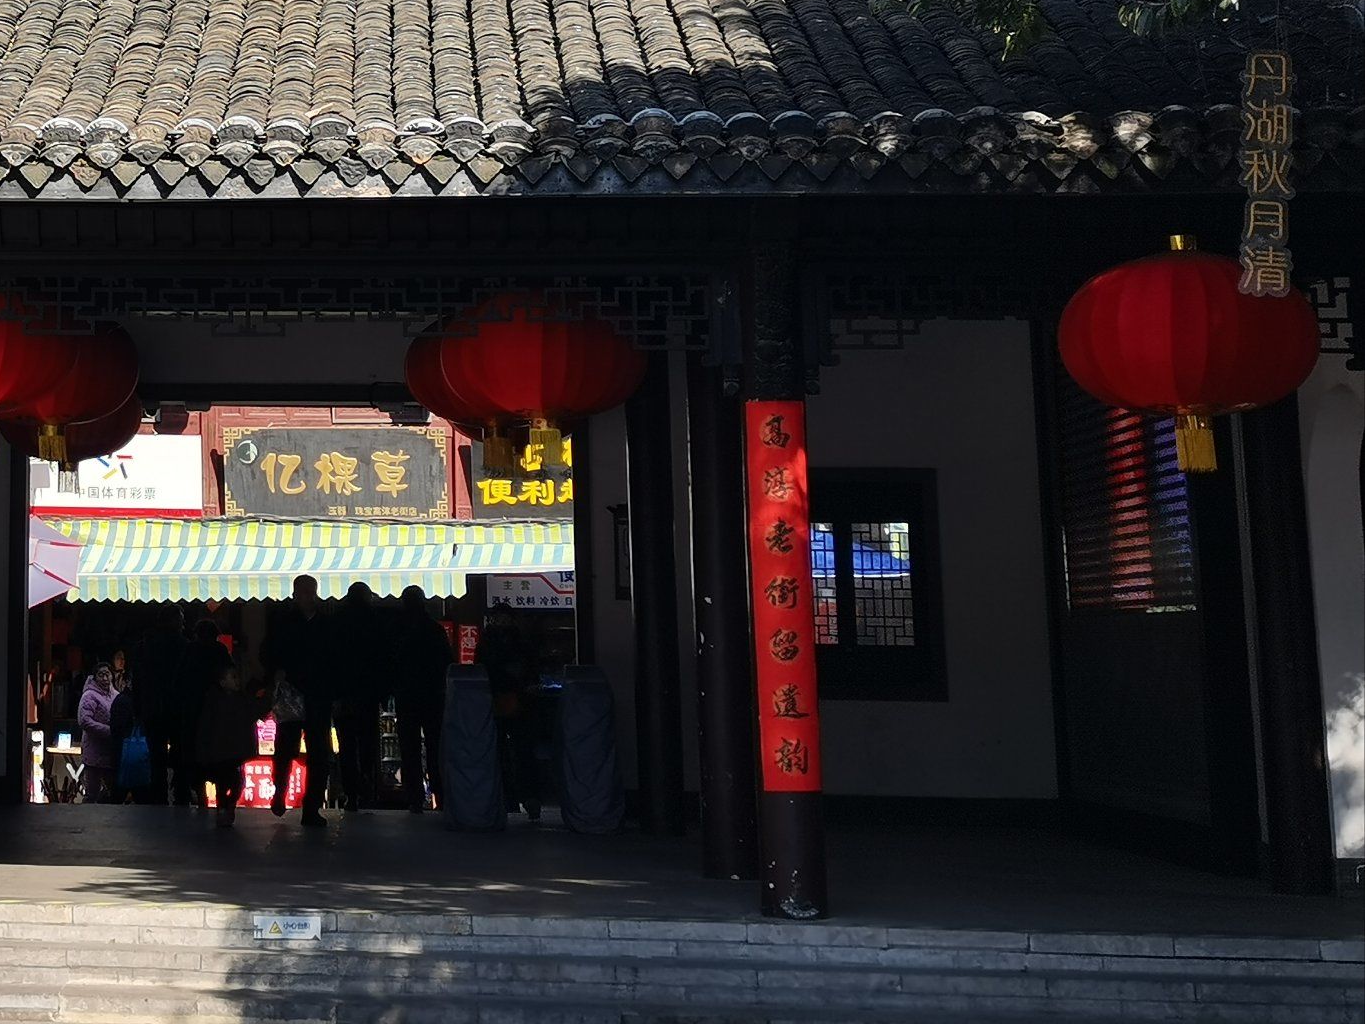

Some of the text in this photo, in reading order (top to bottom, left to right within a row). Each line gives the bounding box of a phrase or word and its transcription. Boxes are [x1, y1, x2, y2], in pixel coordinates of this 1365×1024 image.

[1242, 53, 1292, 293] 丹湖秋月清
[260, 449, 411, 498] 亿棵草
